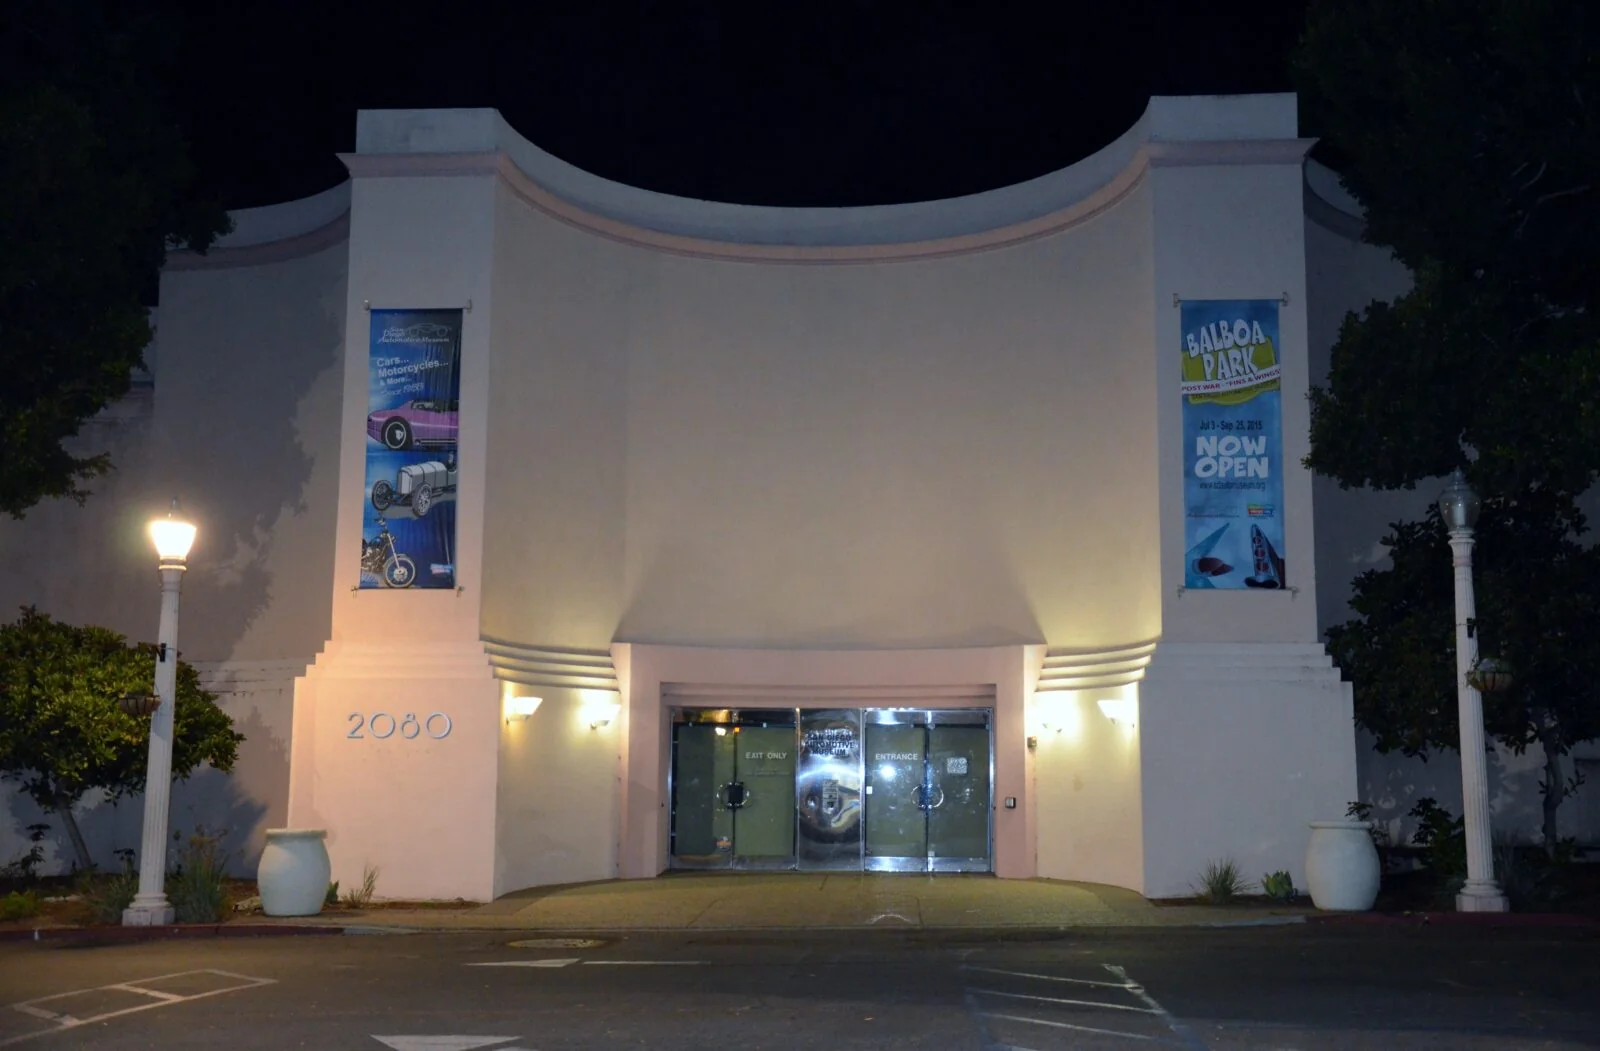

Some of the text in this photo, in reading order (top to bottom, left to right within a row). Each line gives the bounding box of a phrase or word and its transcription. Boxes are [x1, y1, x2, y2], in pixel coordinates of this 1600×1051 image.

[1186, 319, 1266, 358] BALBOA
[1202, 345, 1258, 380] PARK
[1200, 420, 1210, 430] Jul
[1220, 420, 1233, 432] Sep
[1196, 435, 1266, 457] NOW
[1194, 456, 1269, 478] OPEN
[347, 711, 452, 740] 2080
[745, 751, 763, 759] EXIT
